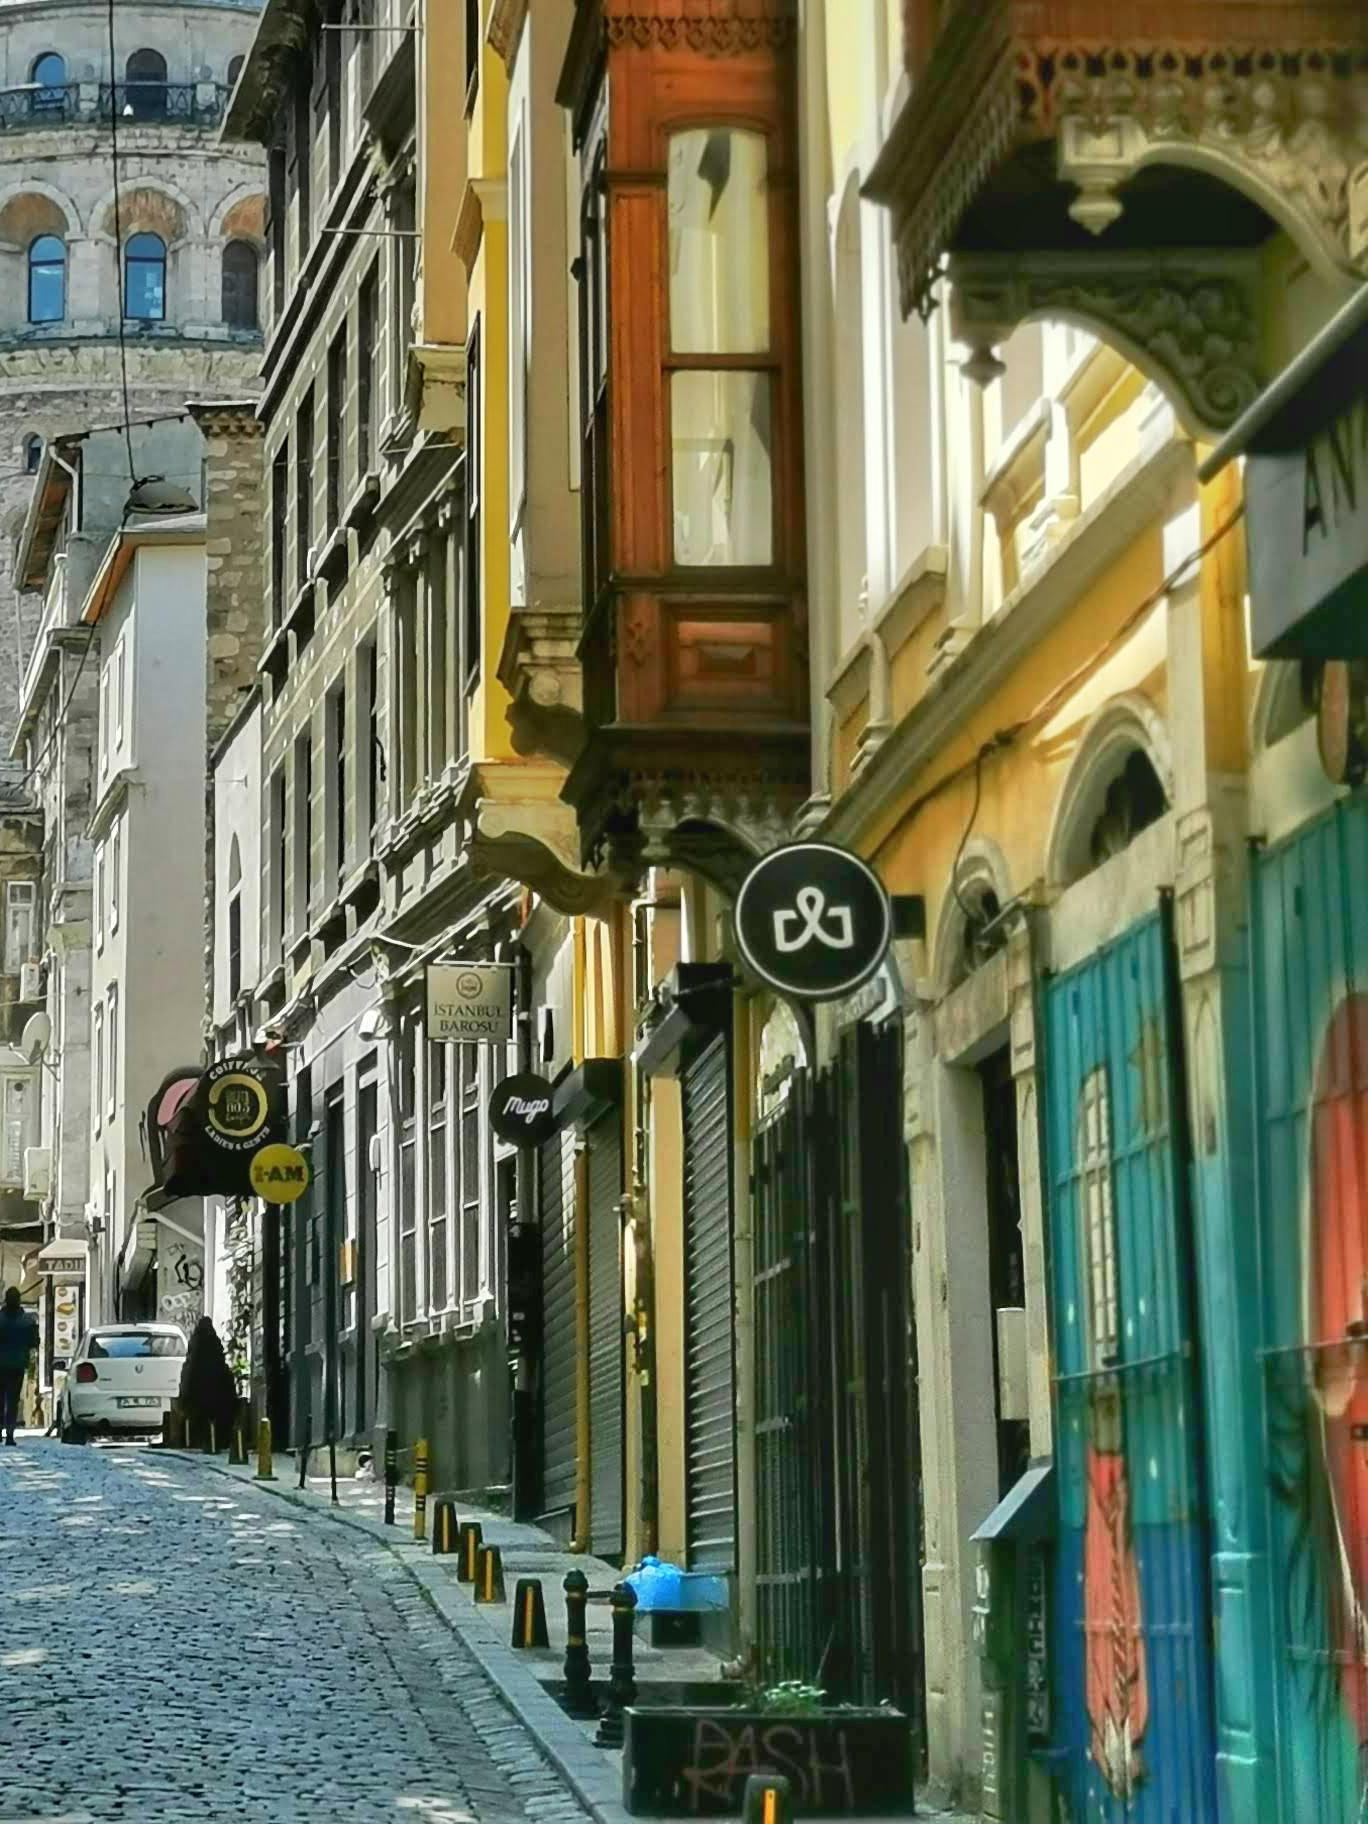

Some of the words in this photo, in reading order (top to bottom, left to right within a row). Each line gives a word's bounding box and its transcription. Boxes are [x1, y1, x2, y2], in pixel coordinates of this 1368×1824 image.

[440, 1019, 499, 1034] BAROSU
[502, 1096, 549, 1124] Mugo
[254, 1165, 304, 1182] I-AM
